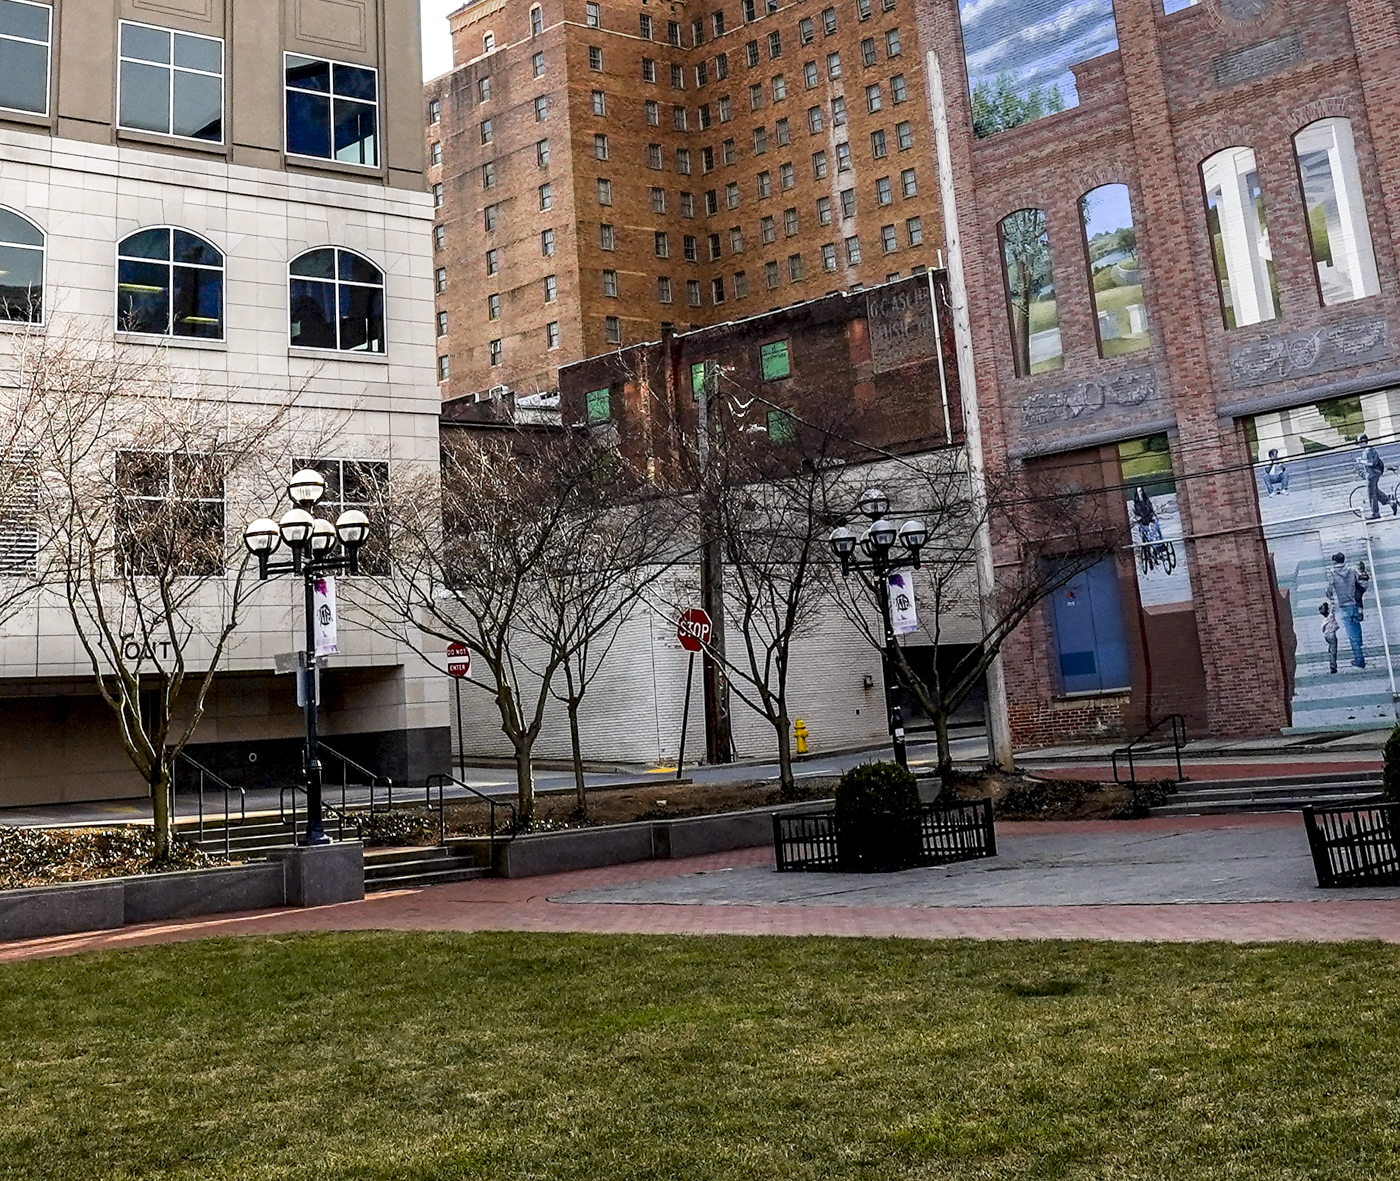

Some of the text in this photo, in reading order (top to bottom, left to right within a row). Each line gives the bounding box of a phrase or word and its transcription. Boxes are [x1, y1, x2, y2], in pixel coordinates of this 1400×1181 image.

[679, 620, 709, 639] STOP
[125, 641, 171, 660] OUT
[449, 663, 466, 671] ENTER
